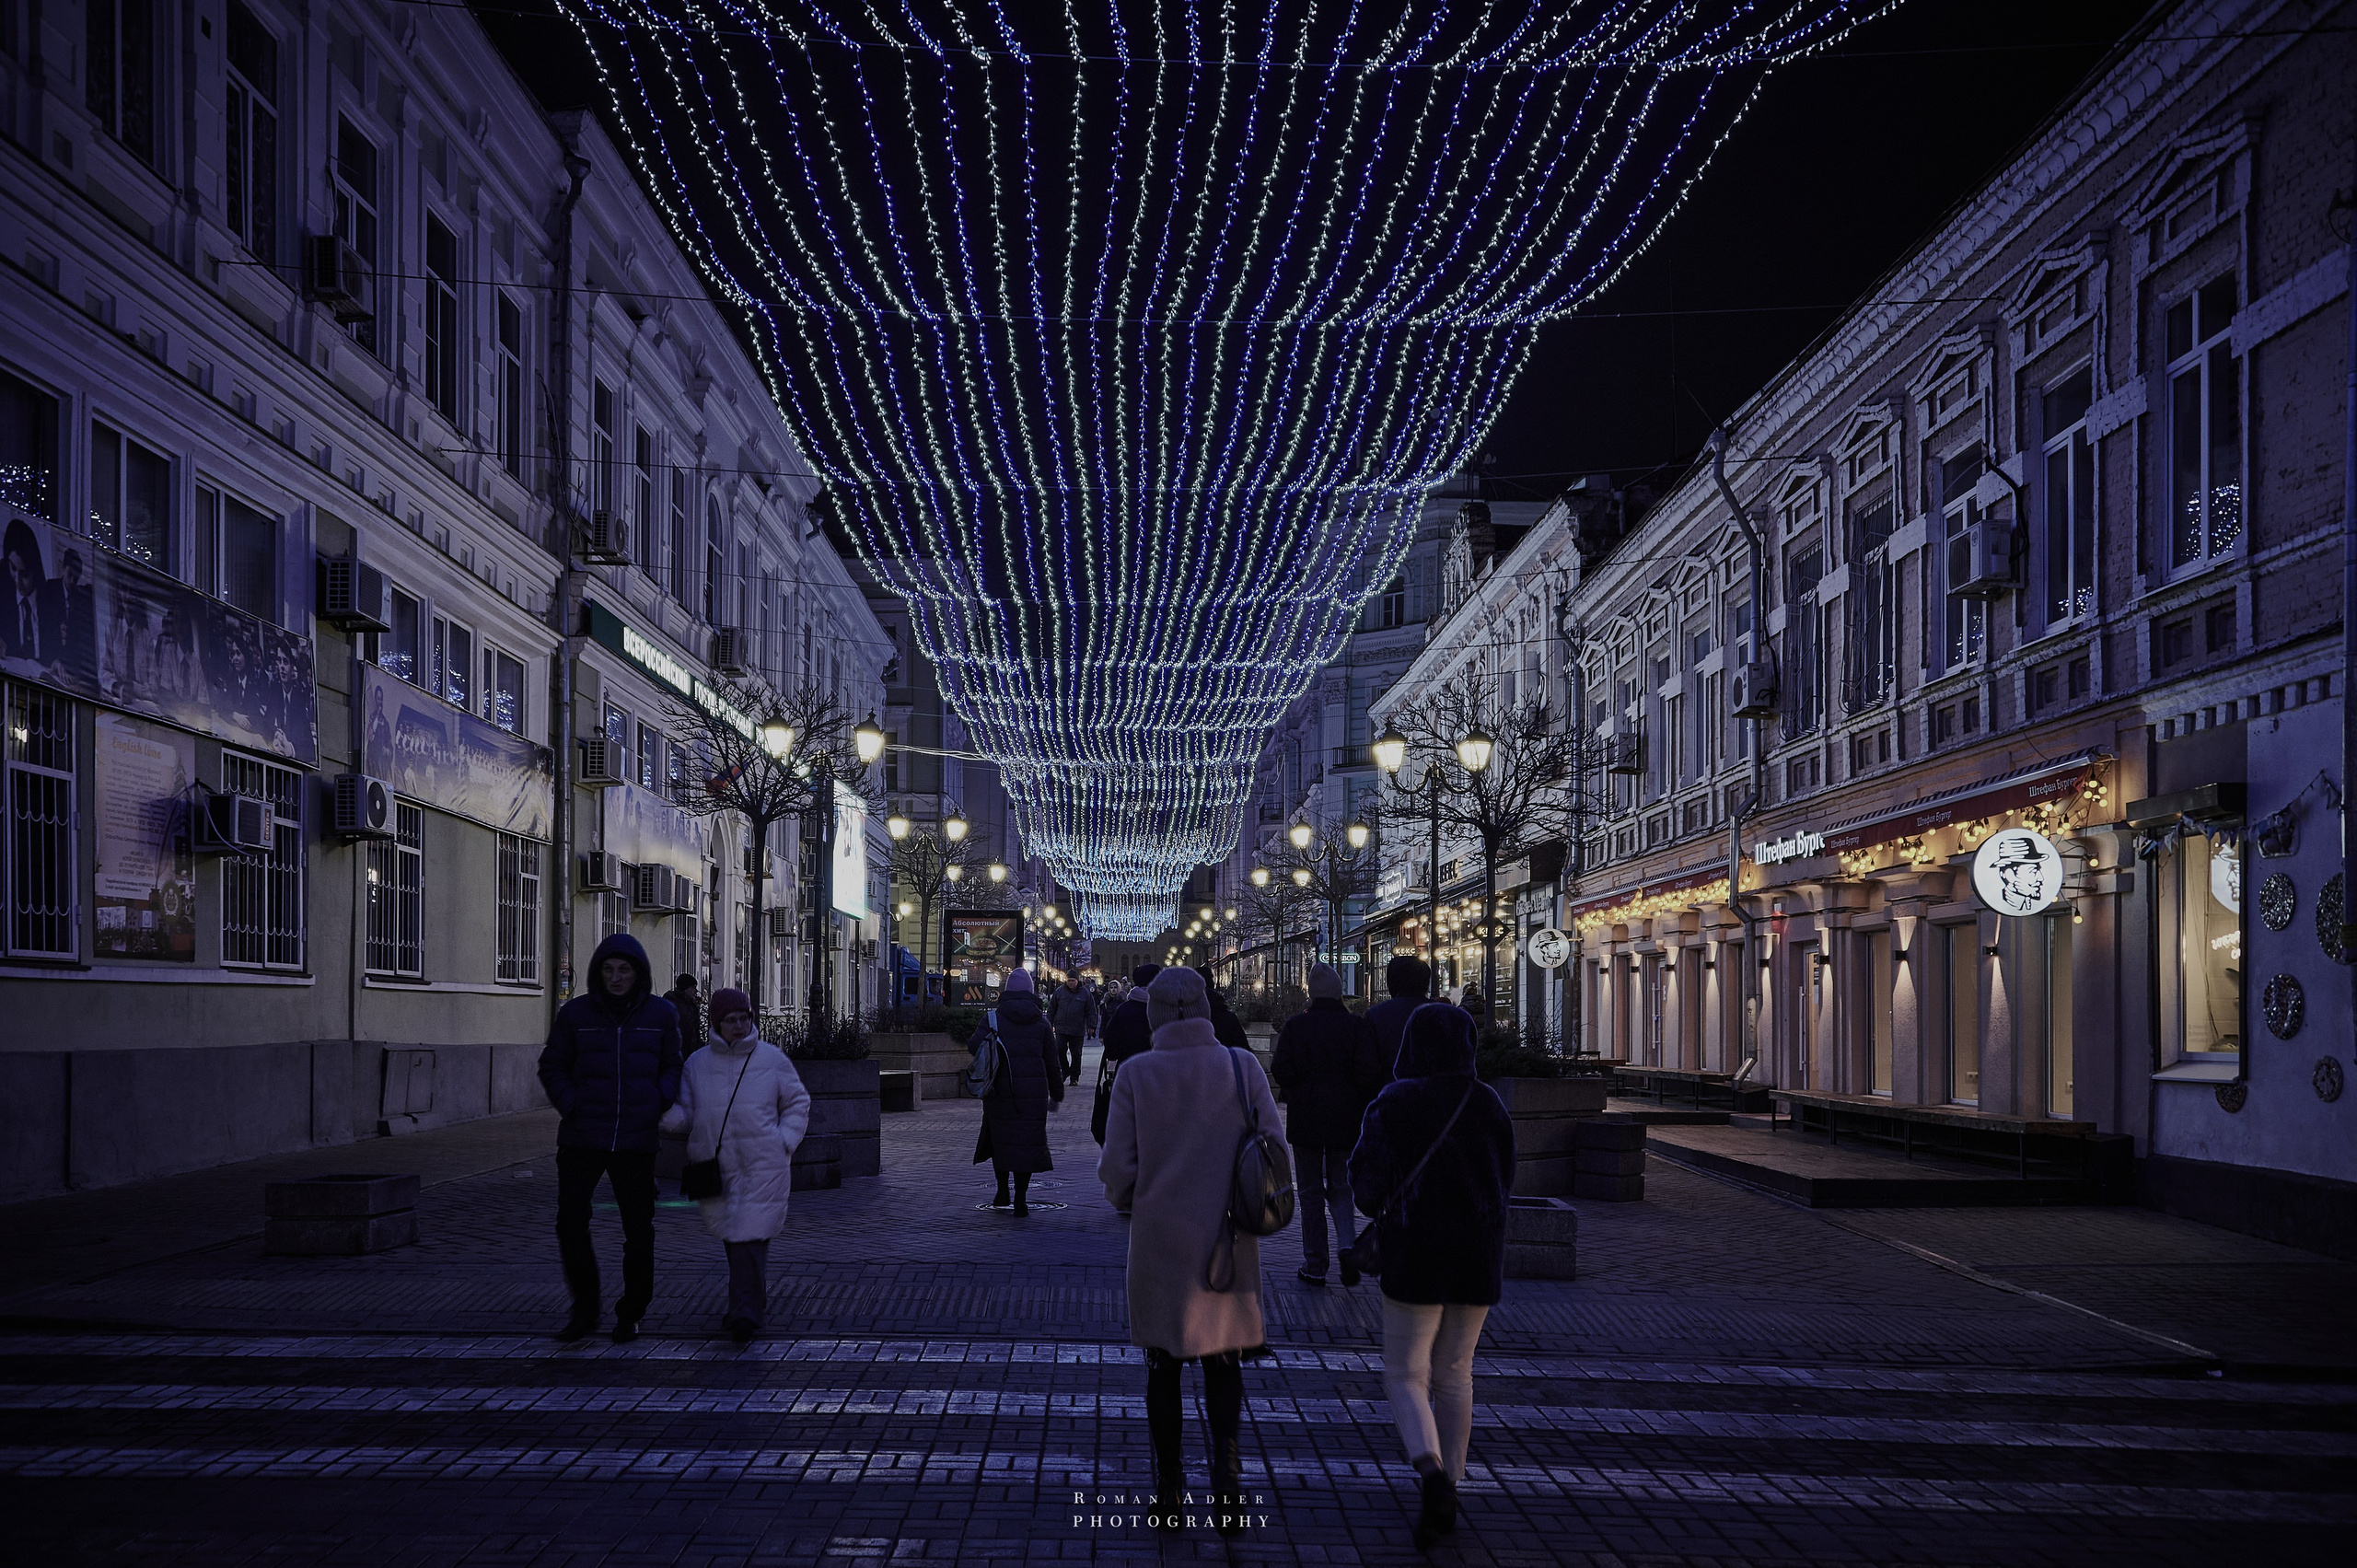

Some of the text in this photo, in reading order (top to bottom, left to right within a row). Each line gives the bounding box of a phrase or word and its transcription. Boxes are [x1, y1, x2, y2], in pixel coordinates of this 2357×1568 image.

[623, 626, 691, 696] ВСЕРОССИЙСКИЙ
[2029, 783, 2057, 797] Штефан
[1917, 810, 1952, 827] Штефан Бургер
[1755, 836, 1796, 865] Штефан
